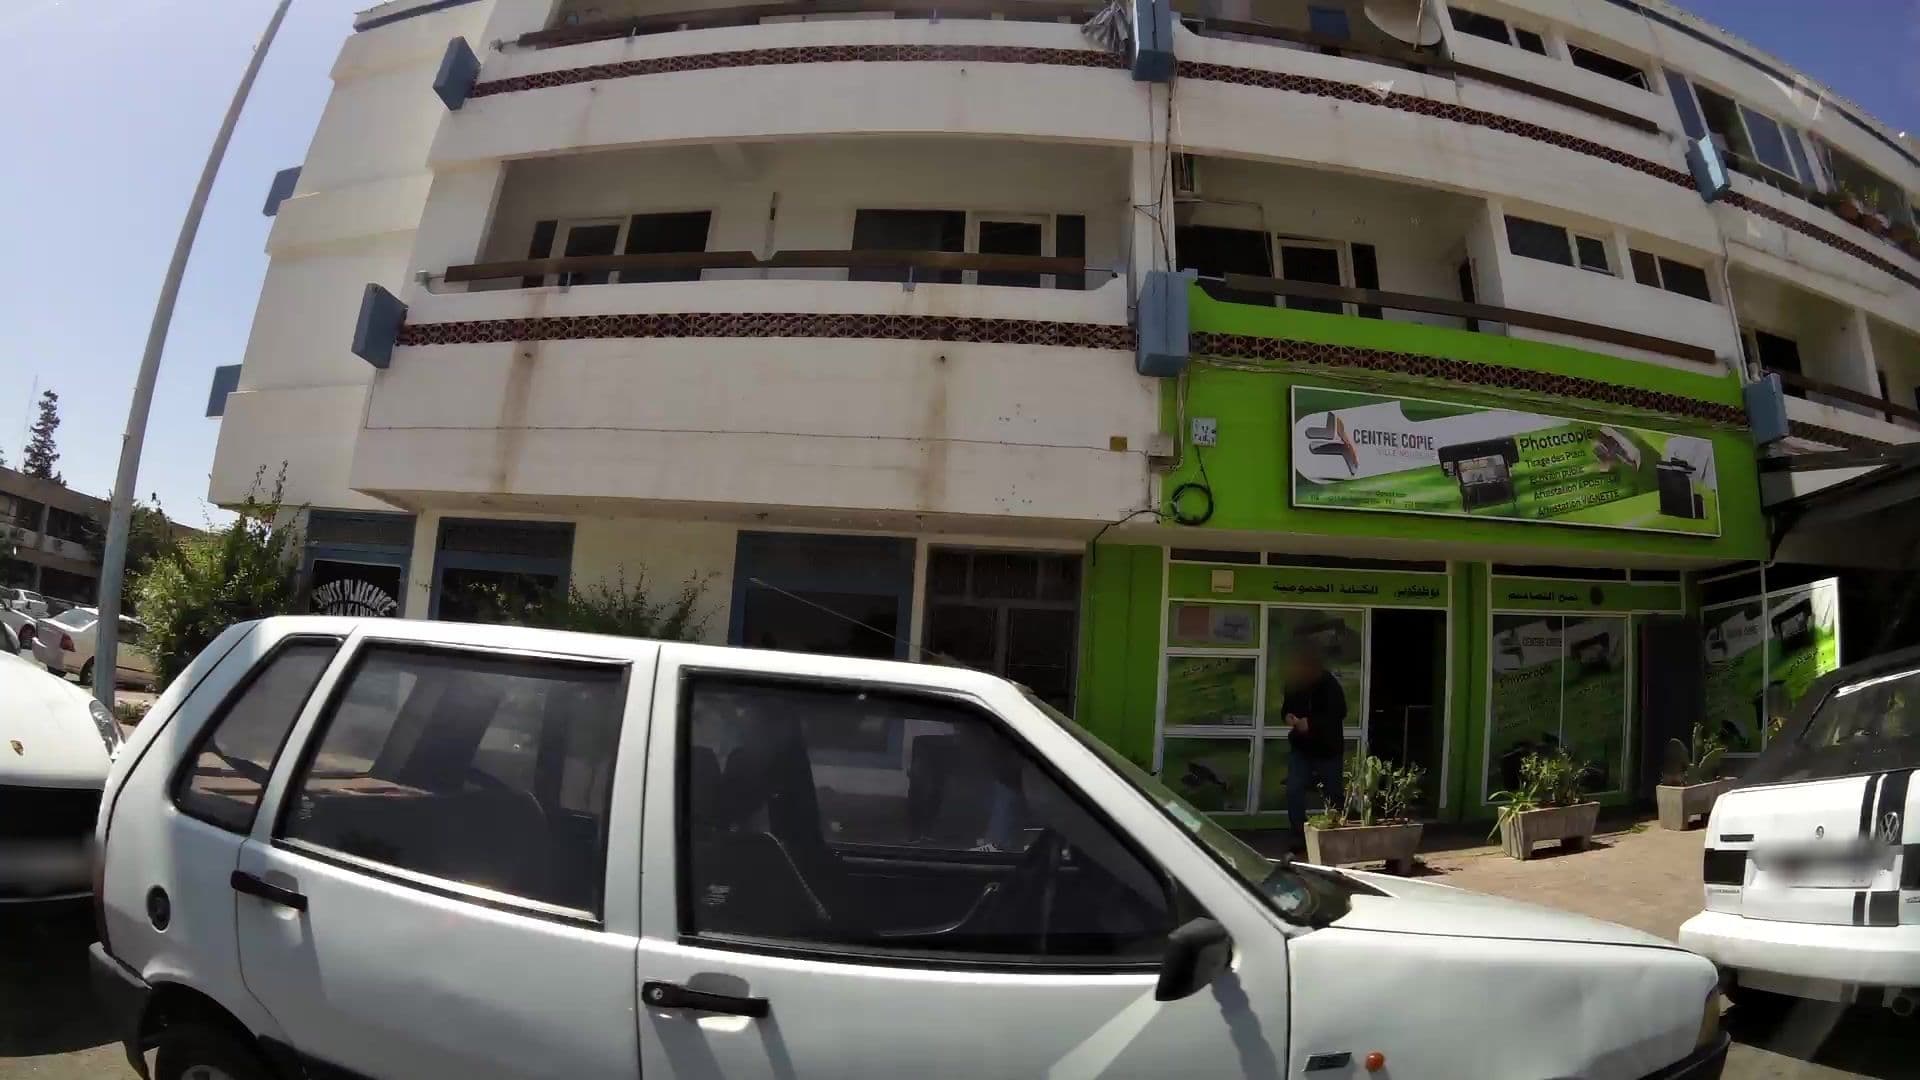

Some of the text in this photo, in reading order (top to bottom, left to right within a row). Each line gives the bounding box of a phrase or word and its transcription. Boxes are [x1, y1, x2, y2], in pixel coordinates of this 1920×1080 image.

[1353, 429, 1434, 450] CENTRE COPIE
[1520, 429, 1593, 453] Photocopie
